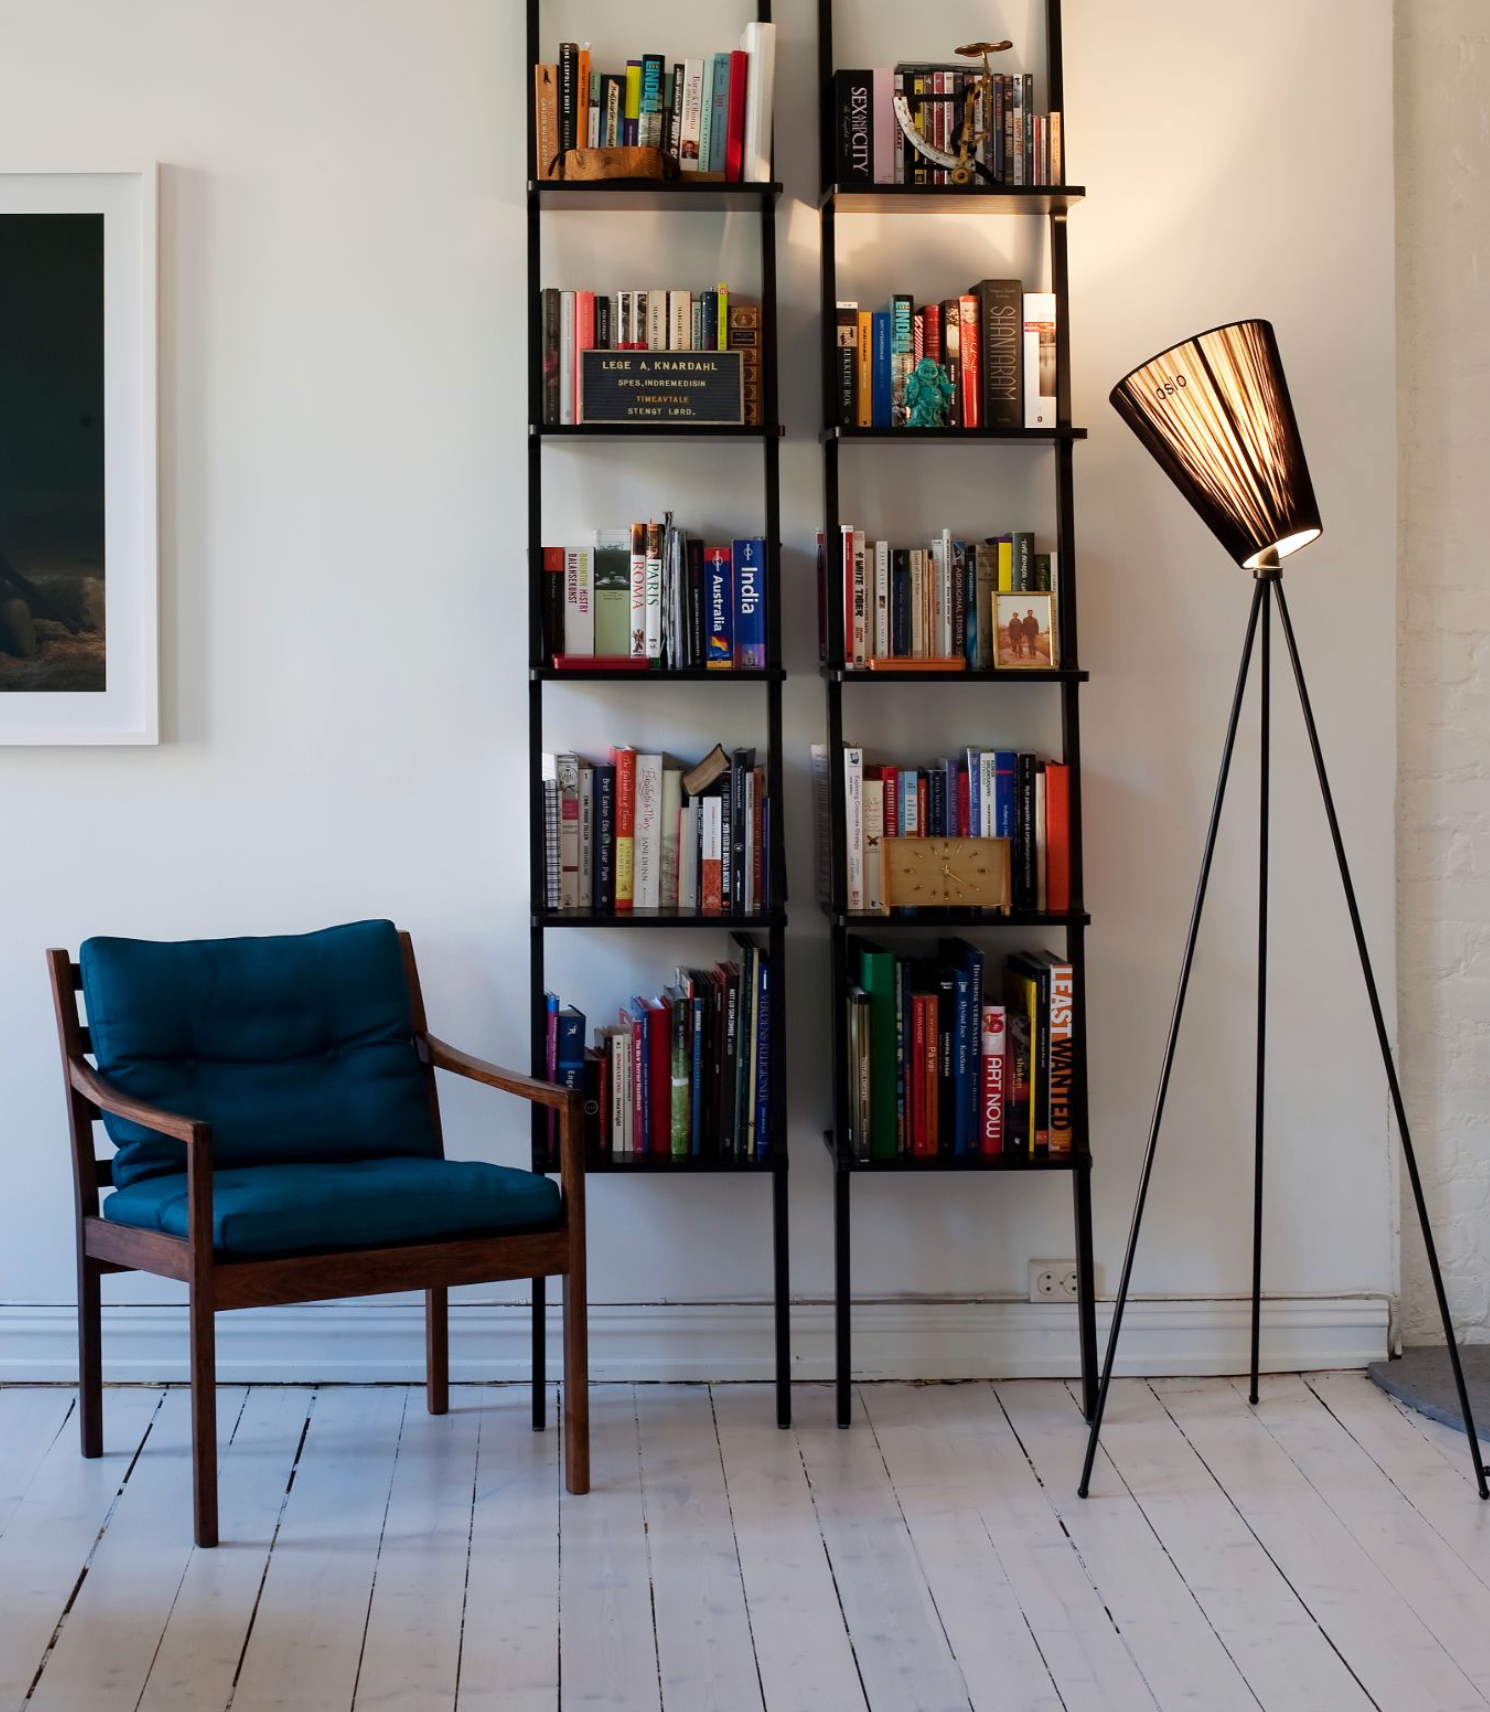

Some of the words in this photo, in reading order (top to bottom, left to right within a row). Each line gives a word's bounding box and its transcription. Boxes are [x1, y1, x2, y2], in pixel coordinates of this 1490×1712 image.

[850, 87, 868, 116] SEX
[852, 133, 868, 173] CITY
[602, 361, 632, 370] LEGE
[640, 361, 652, 371] A.
[654, 361, 719, 371] KNARDAHL
[990, 305, 1017, 400] SHANTARAM
[843, 348, 852, 387] LUKKEDE
[627, 407, 662, 416] STENGT
[636, 395, 690, 404] TIMEAVTALE
[843, 389, 852, 406] BOK
[568, 553, 578, 604] BALANSEKUNST
[632, 561, 645, 610] ROMA
[648, 563, 660, 607] PARIS
[855, 560, 864, 586] WHITE
[579, 588, 589, 613] MISTRY
[712, 574, 725, 632] Australia
[741, 566, 760, 615] India
[855, 588, 864, 618] TIGER
[955, 567, 964, 613] ABORIGINAL
[955, 614, 964, 645] STORIES
[602, 777, 611, 792] Bret
[853, 775, 862, 800] Exploring
[602, 795, 611, 818] Easton
[853, 801, 862, 827] Corporate
[641, 837, 650, 858] JANE
[853, 828, 863, 850] Strategy
[601, 844, 610, 864] Lunar
[601, 866, 610, 882] Park
[641, 858, 650, 881] DUNN
[1050, 967, 1073, 1037] LEAST
[758, 993, 770, 1041] VERDENS
[927, 1046, 937, 1058] På
[927, 1058, 937, 1072] vei
[758, 1042, 770, 1102] RELIGIONER
[985, 1057, 1003, 1091] ART
[1015, 1057, 1025, 1089] shaken
[1050, 1037, 1073, 1131] WANTED
[985, 1093, 1003, 1139] NOW
